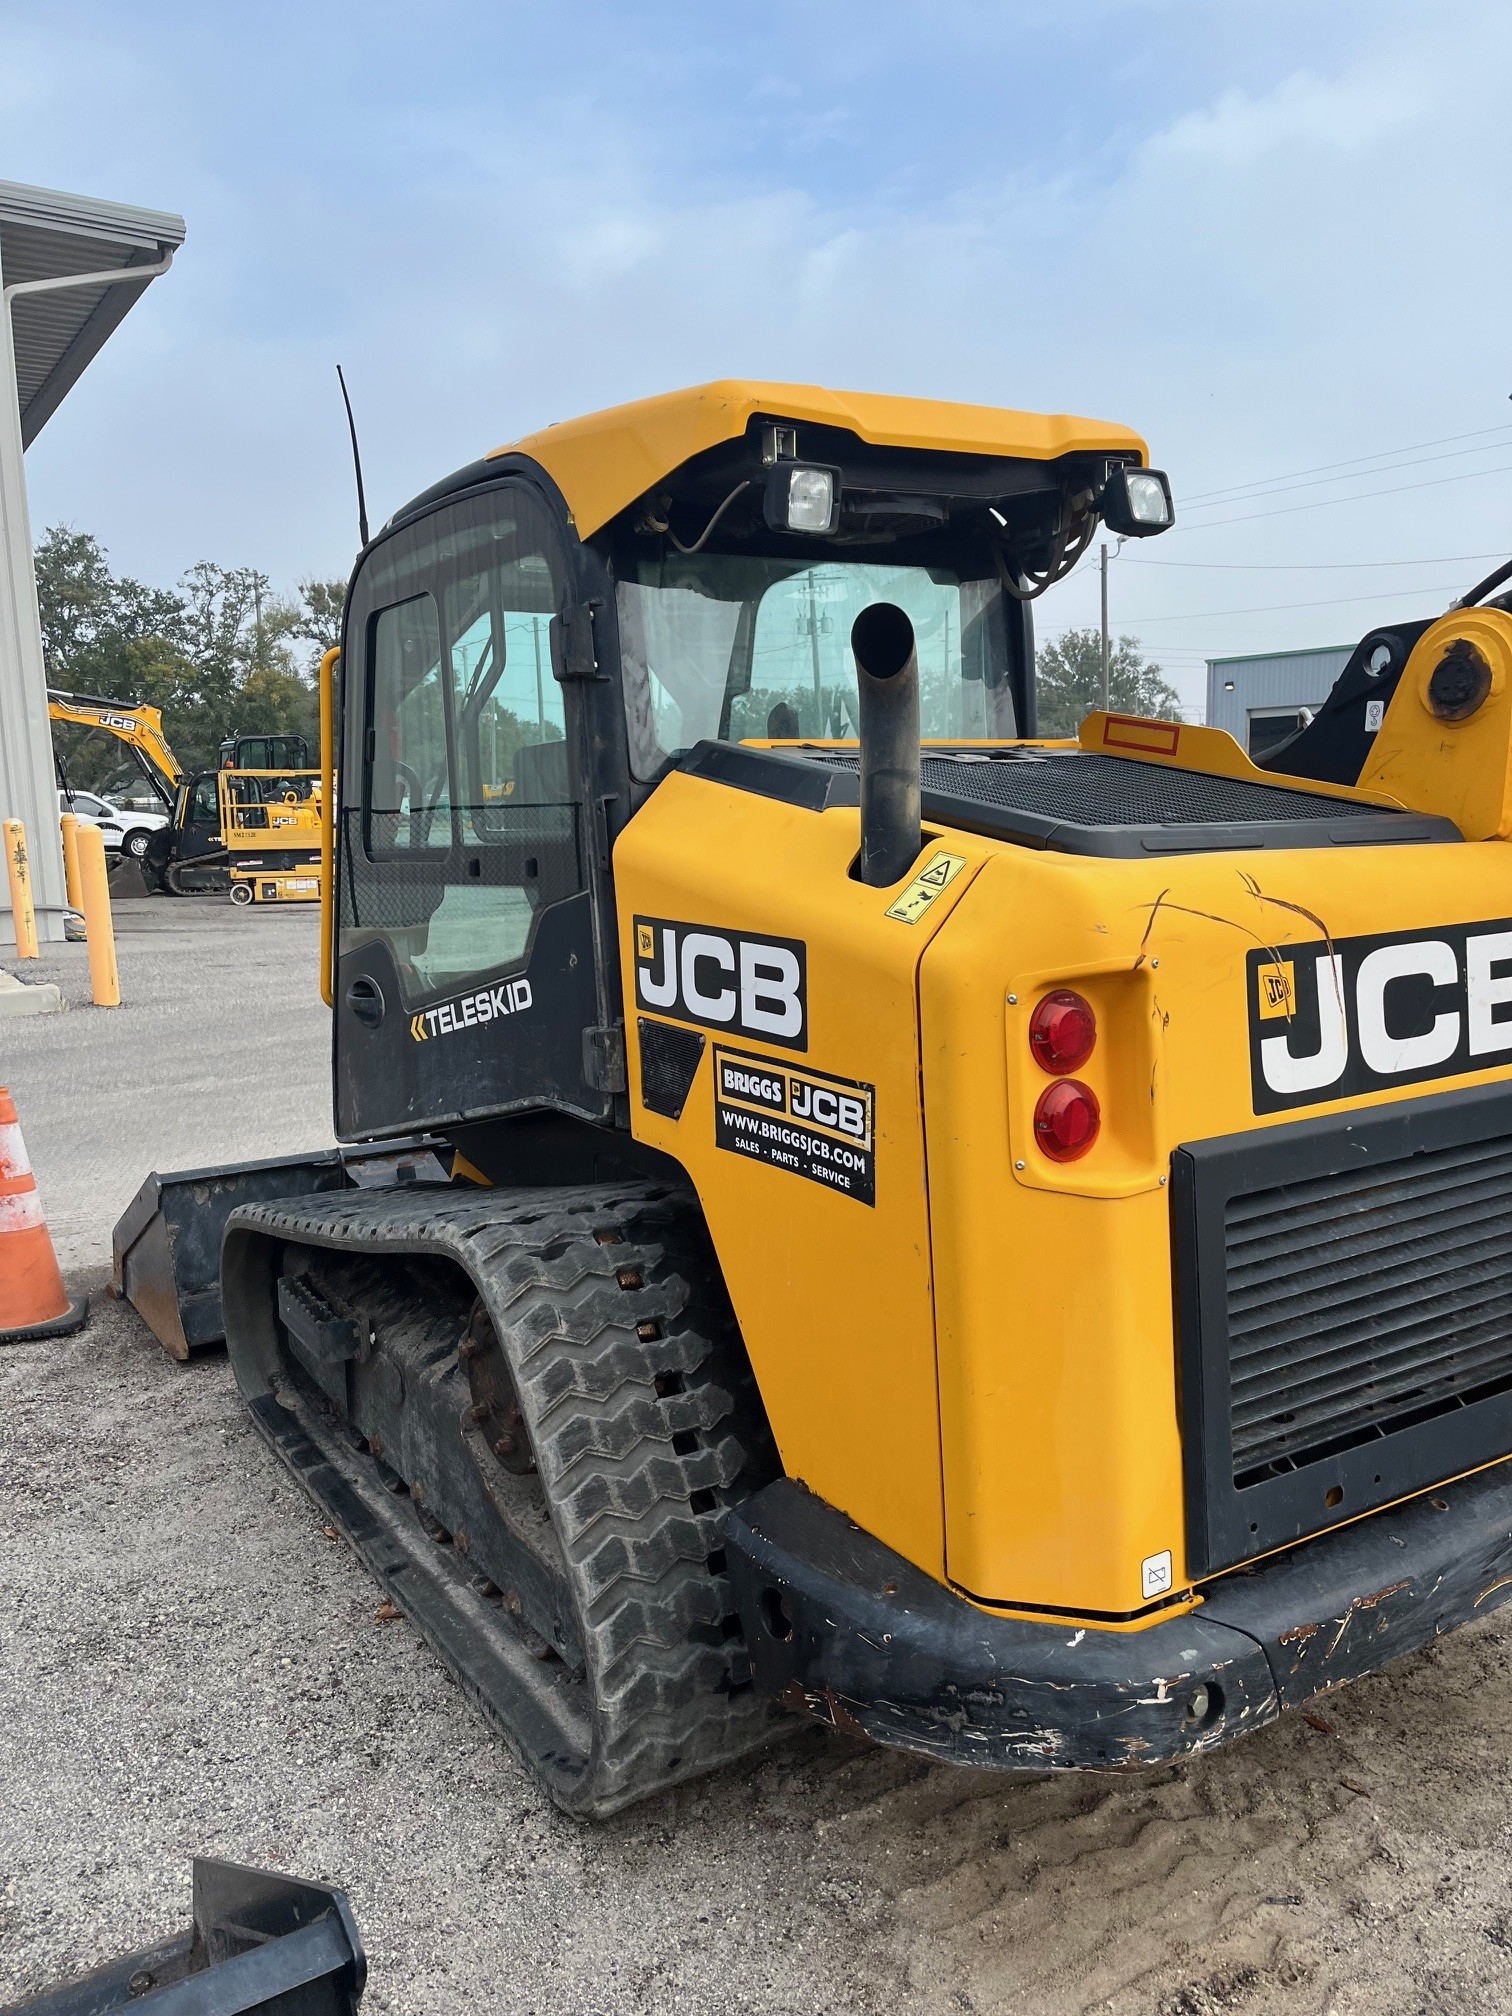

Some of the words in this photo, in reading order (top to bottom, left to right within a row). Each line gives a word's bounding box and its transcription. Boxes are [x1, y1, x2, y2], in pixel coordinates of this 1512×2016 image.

[100, 716, 136, 731] JCB
[272, 817, 297, 825] JCB
[425, 978, 533, 1037] TELESKID
[639, 929, 803, 1038] JCB
[724, 1068, 782, 1103] BRIGGS
[792, 1085, 864, 1136] JCB
[722, 1110, 866, 1174] WWW.BRIGGSJCB.COM
[735, 1137, 760, 1154] SALES
[771, 1148, 799, 1168] PARTS
[811, 1163, 851, 1189] SERVICE
